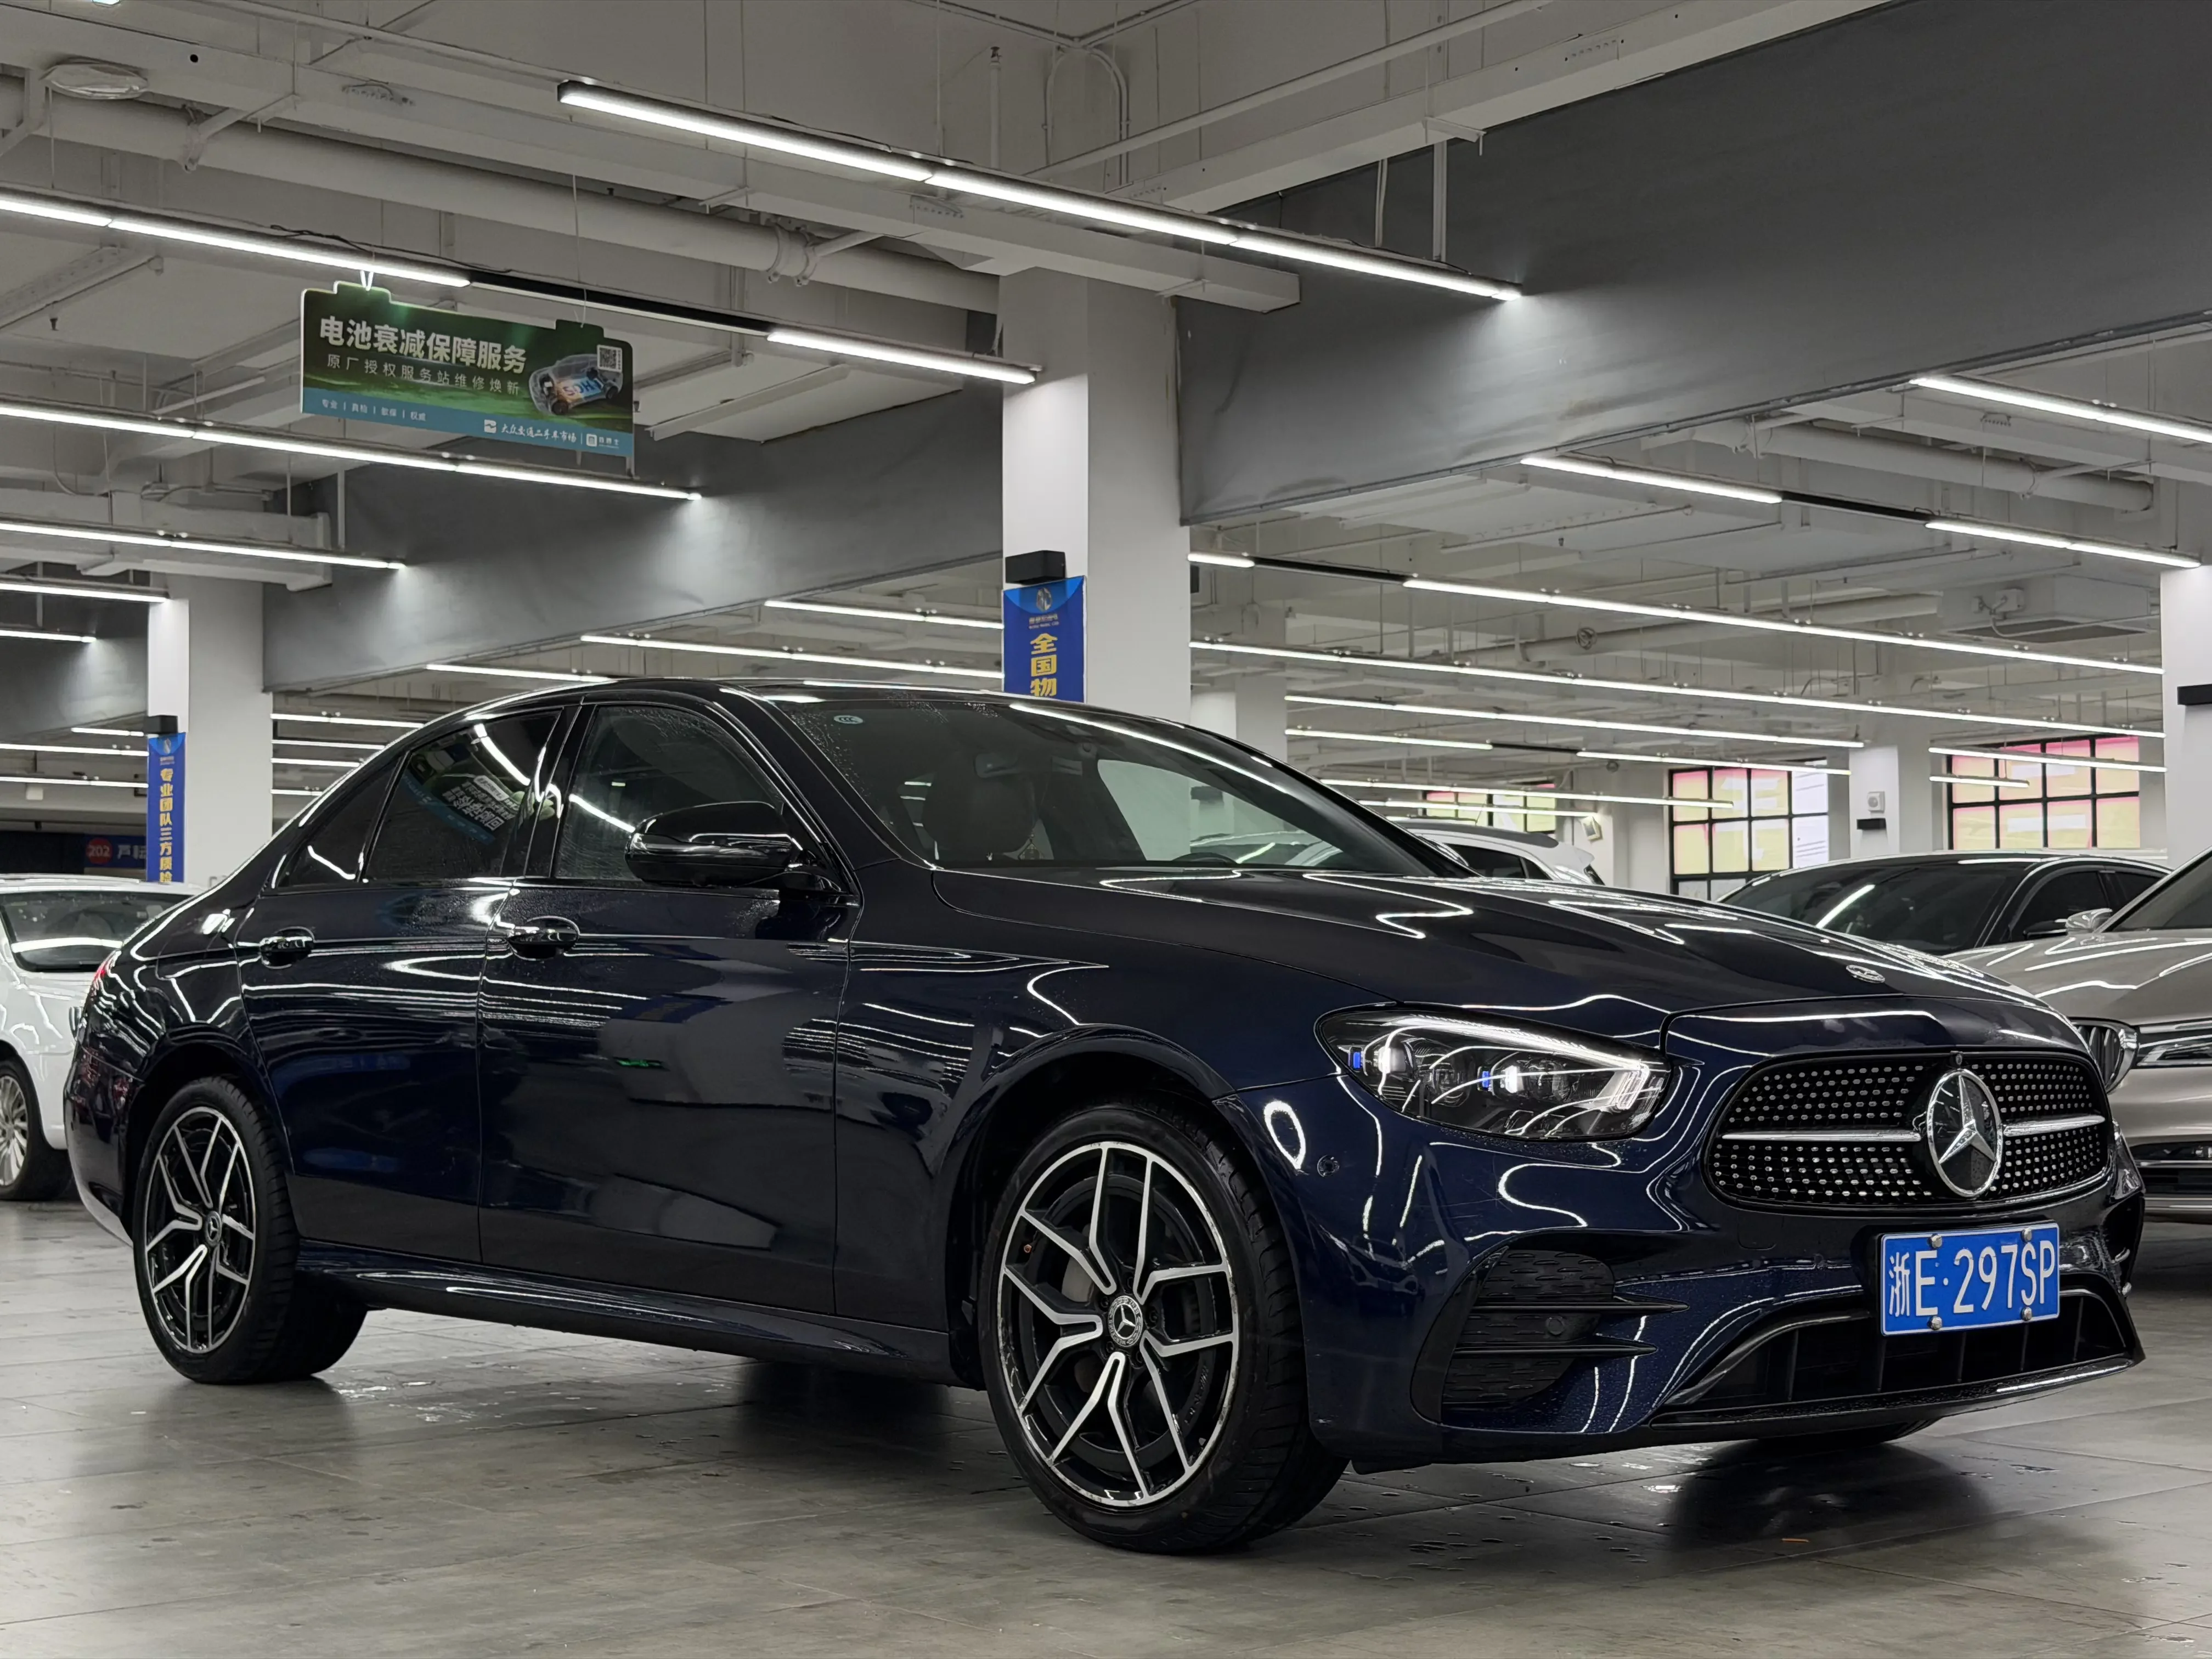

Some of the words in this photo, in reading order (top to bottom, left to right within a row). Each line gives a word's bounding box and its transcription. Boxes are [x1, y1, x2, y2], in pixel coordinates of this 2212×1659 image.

[320, 315, 527, 374] 电池衰减保障服务
[327, 354, 520, 396] 原厂授权服务站维修焕新
[1030, 633, 1058, 697] 全国物
